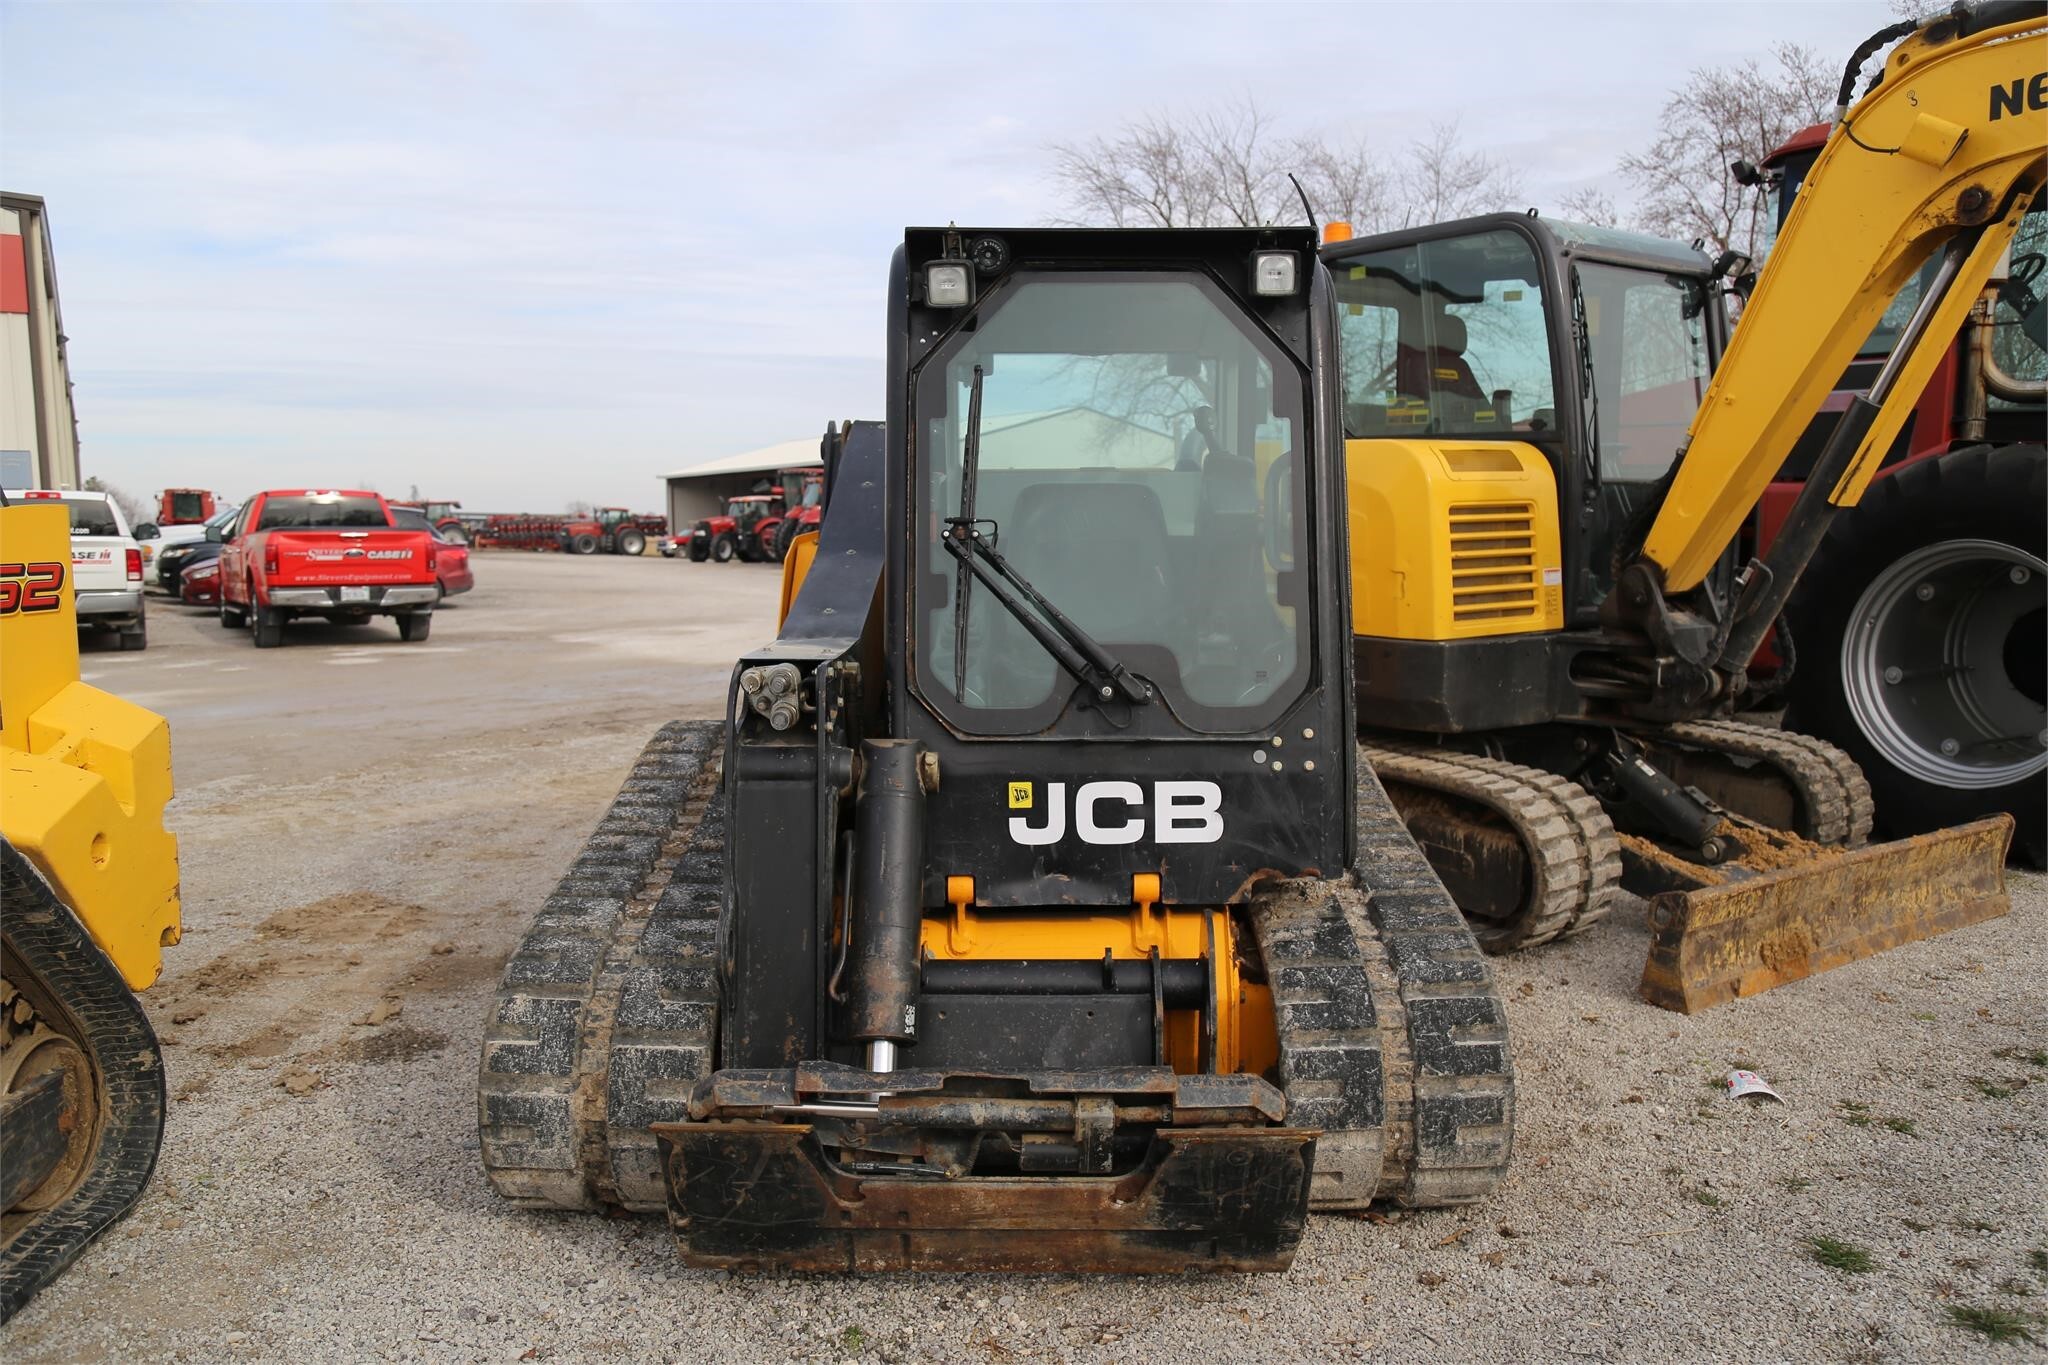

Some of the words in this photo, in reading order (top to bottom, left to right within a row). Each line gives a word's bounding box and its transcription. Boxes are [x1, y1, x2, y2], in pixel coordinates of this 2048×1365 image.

[1989, 71, 2048, 122] NE
[367, 550, 401, 559] CASE
[1014, 788, 1029, 801] JCB
[1008, 780, 1224, 845] JCB
